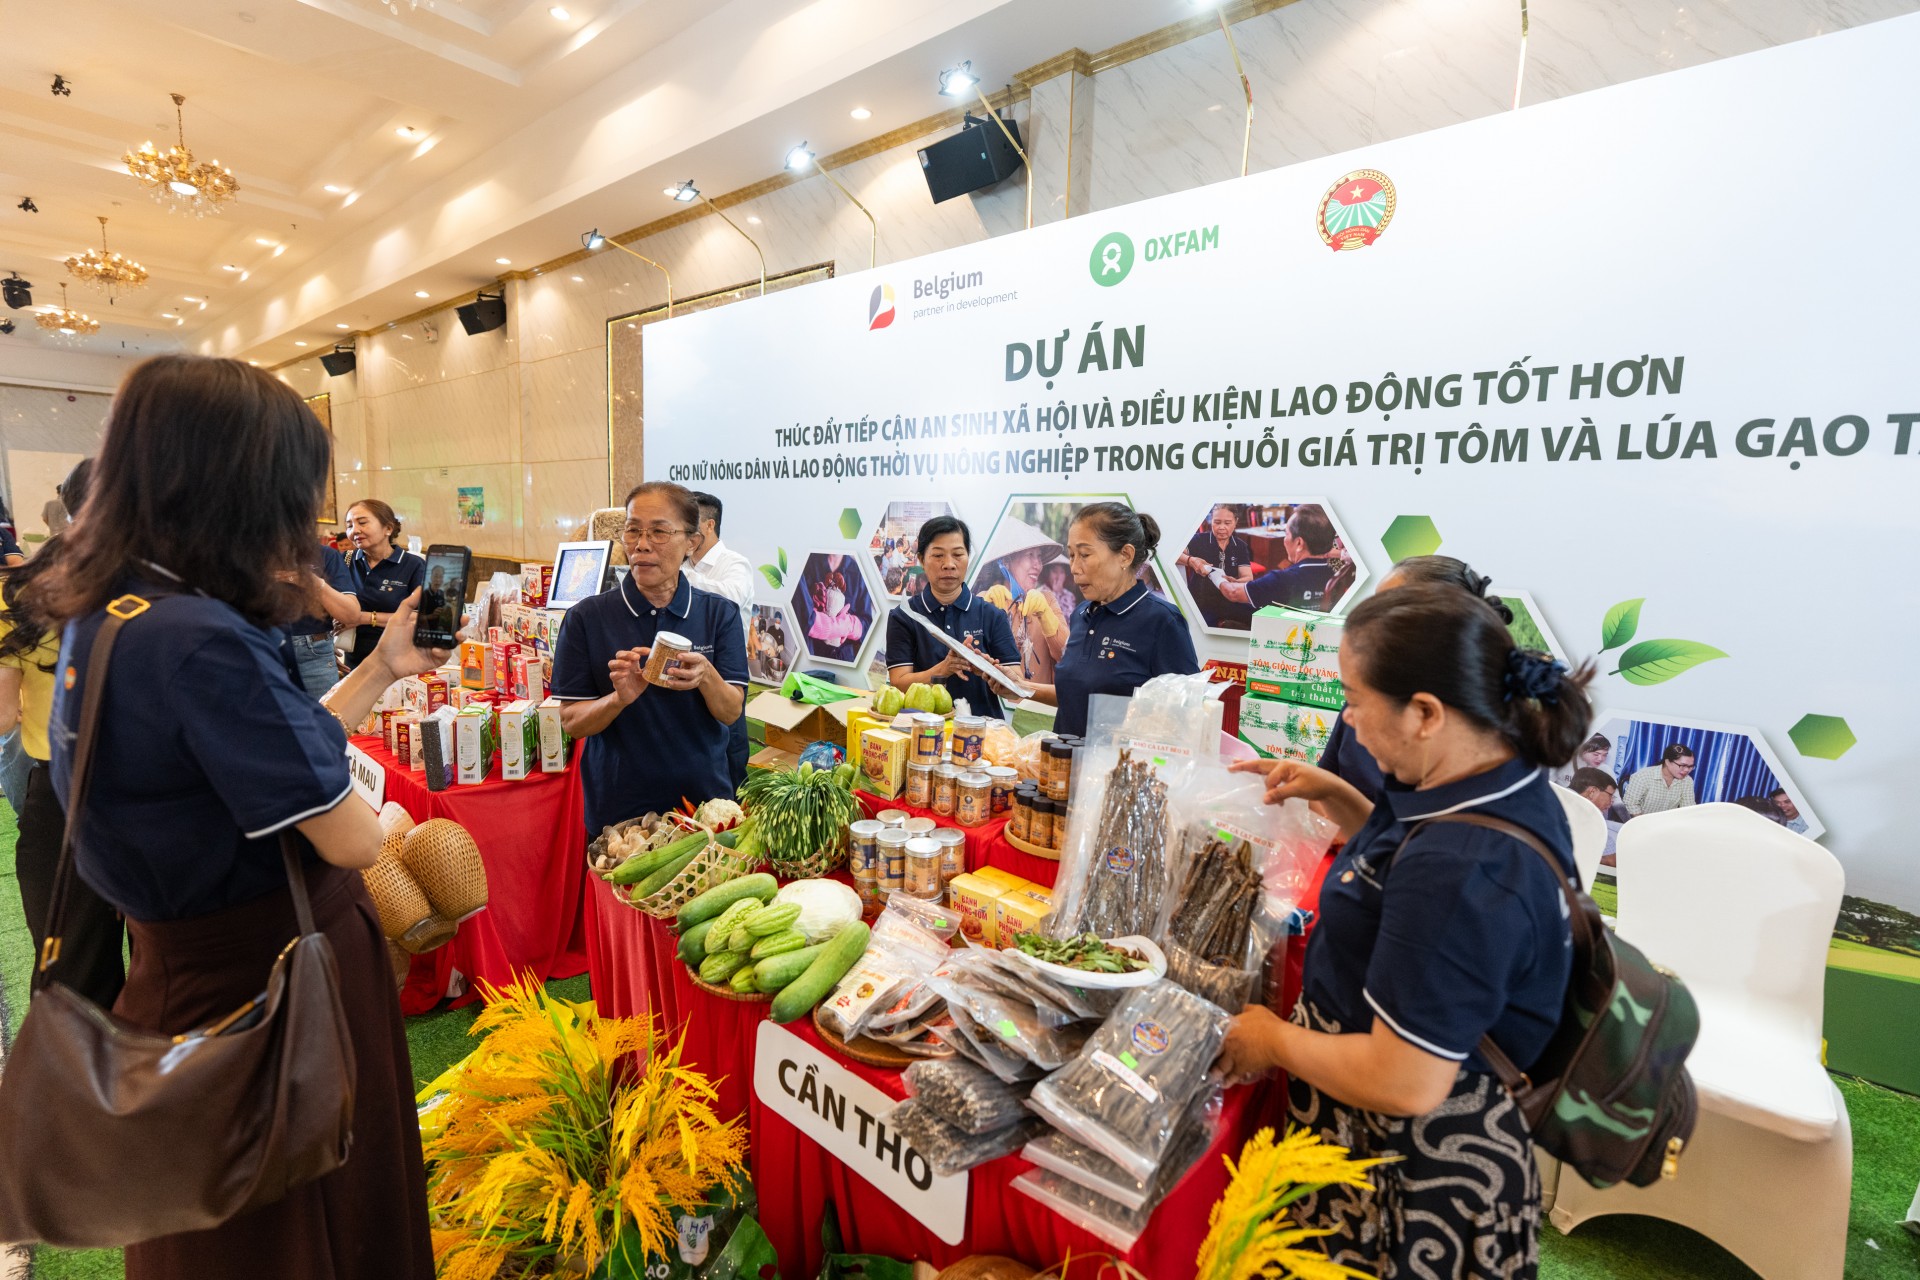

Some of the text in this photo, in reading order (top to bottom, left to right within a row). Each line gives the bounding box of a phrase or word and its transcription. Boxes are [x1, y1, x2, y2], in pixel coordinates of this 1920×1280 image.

[1144, 224, 1219, 262] OXFAM
[913, 271, 983, 300] Belgium
[913, 290, 1018, 320] partner in development
[1005, 320, 1145, 391] DỰ ÁN
[775, 354, 1685, 447] THÚC ĐẨY TIẾP CẬN AN SINH XÃ HỘI VÀ ĐIỀU KIỆN LAO ĐỘNG TỐT HƠN
[669, 413, 1920, 483] CHO NỮ NÔNG DÂN VÀ LAO ĐỘNG THỜI VỤ NÔNG NGHIỆP TRONG CHUỖI GIÁ TRỊ TÔM VÀ LÚA GẠO T
[1253, 659, 1270, 669] TÔM
[1315, 668, 1339, 679] VÀNG
[358, 763, 377, 792] MAU
[778, 1058, 846, 1133] CẦN
